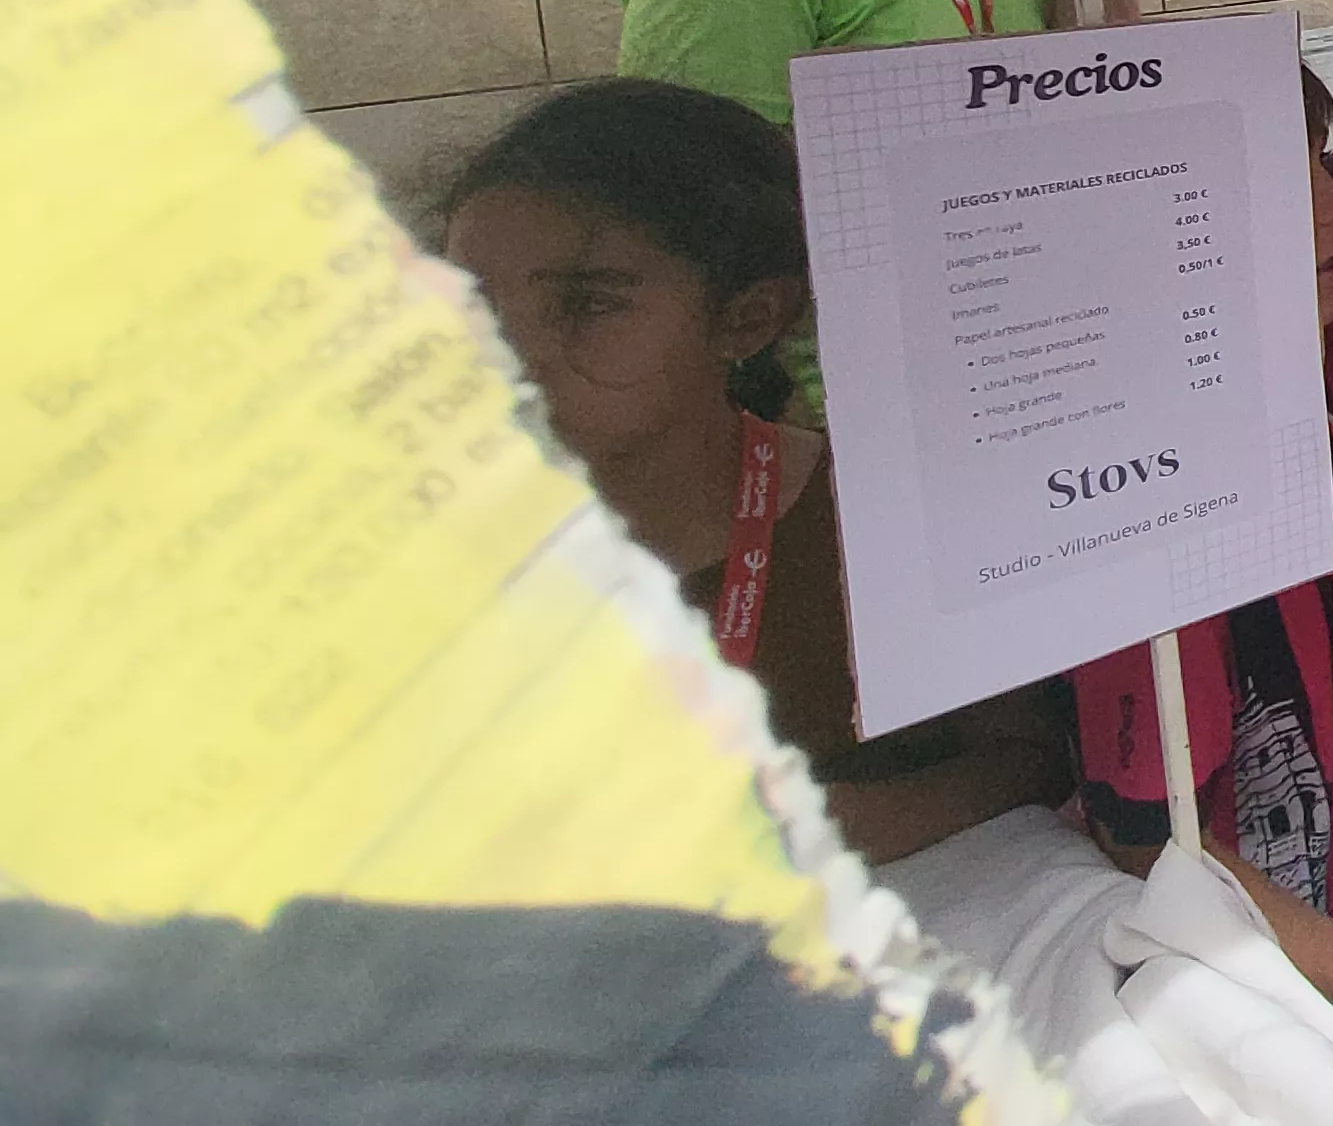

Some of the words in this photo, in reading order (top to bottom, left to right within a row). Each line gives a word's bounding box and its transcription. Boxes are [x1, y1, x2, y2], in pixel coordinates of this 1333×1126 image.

[964, 52, 1163, 110] Precios
[942, 192, 999, 212] JUEGOS
[1003, 190, 1012, 201] Y
[1015, 175, 1103, 199] MATERIALES
[1106, 162, 1188, 185] RECICLADOS
[944, 229, 974, 242] Tres
[993, 249, 1009, 261] de
[955, 330, 992, 346] Papel
[1046, 330, 1105, 354] pequeñas
[1043, 357, 1096, 376] mediana
[1018, 390, 1062, 411] grande
[1020, 415, 1065, 436] grande
[1068, 409, 1089, 422] con
[1047, 448, 1180, 509] Stovs
[979, 550, 1041, 584] Studio
[1058, 519, 1151, 558] Villanueva
[1157, 509, 1178, 527] de
[1183, 491, 1239, 519] Sigena
